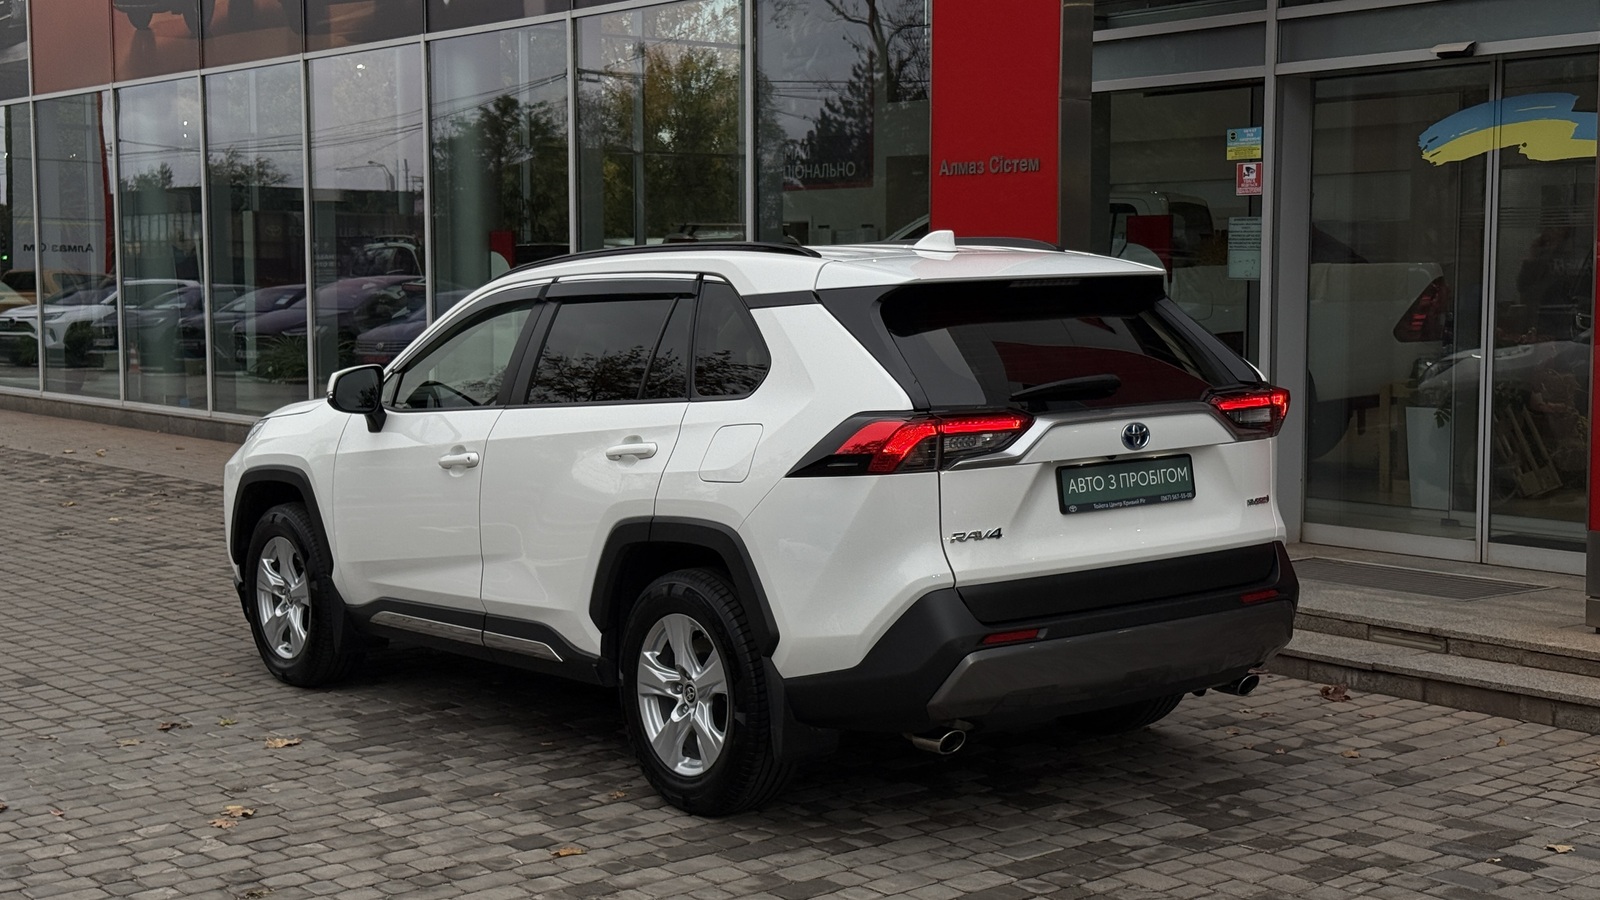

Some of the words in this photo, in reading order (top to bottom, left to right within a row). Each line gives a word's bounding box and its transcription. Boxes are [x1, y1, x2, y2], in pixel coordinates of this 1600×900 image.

[939, 159, 985, 176] Алмаз
[989, 156, 1040, 174] Сістем
[1068, 475, 1105, 494] АВТО
[1119, 466, 1188, 489] ПРОБІГОМ
[949, 527, 1003, 544] RAV4
